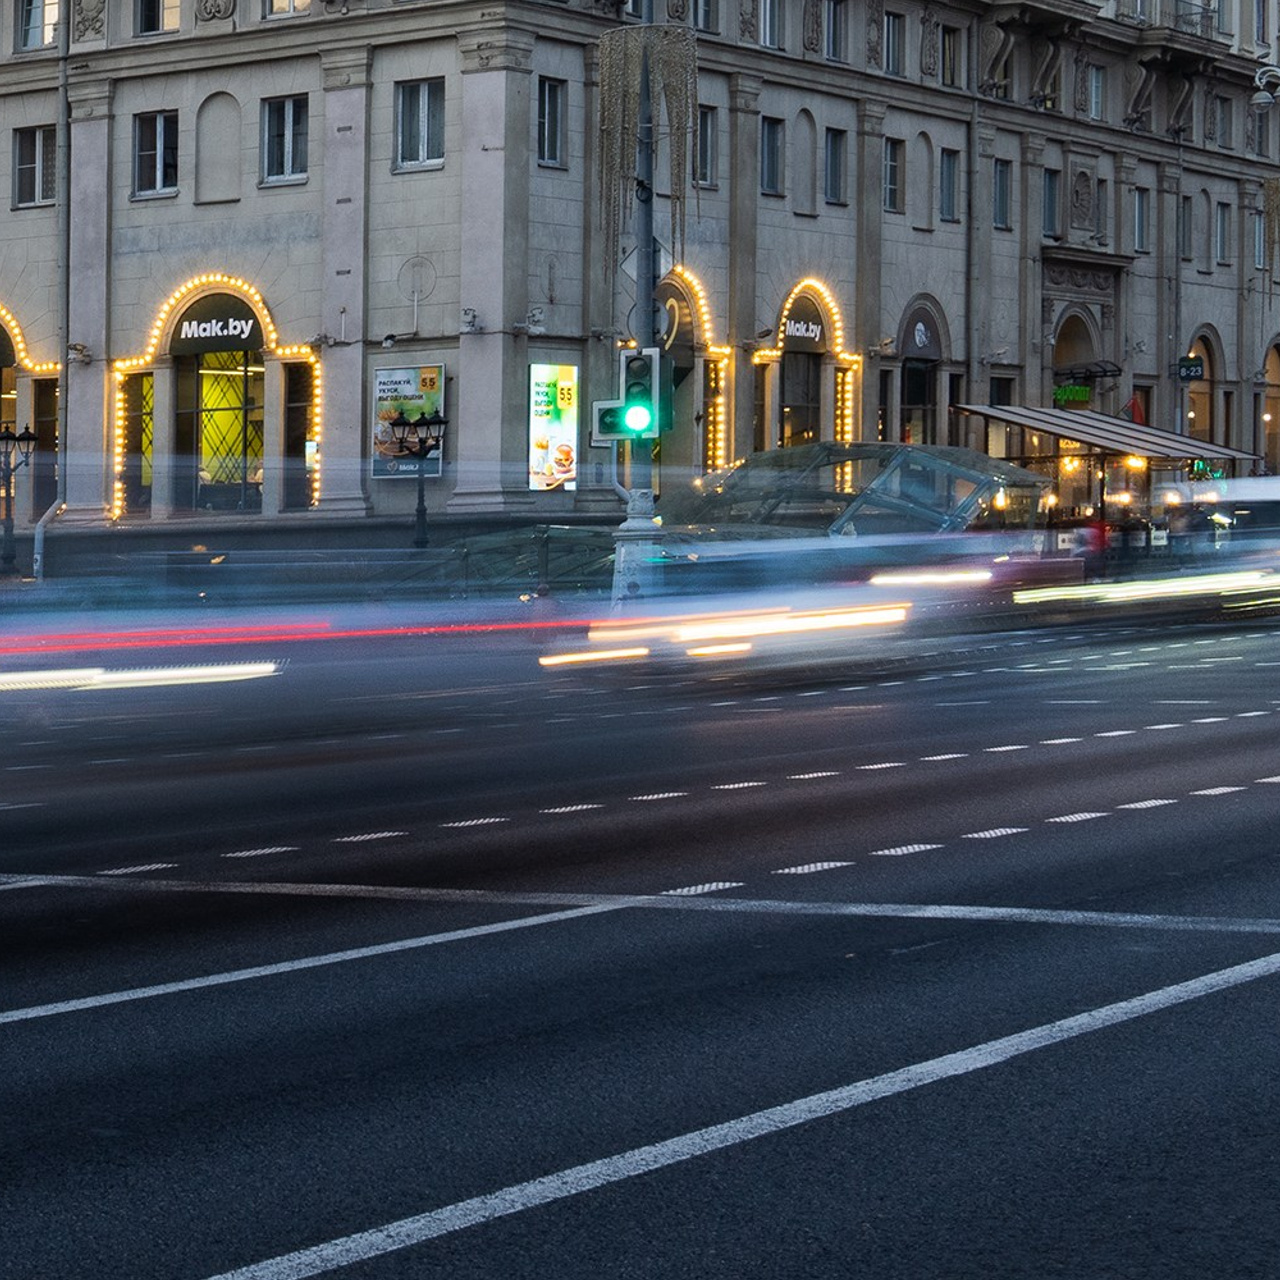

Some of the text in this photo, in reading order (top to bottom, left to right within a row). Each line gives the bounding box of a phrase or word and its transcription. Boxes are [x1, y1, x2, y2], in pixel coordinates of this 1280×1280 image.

[181, 318, 254, 339] Mak.by
[786, 320, 822, 342] Mak.by
[1180, 366, 1202, 377] 8-23
